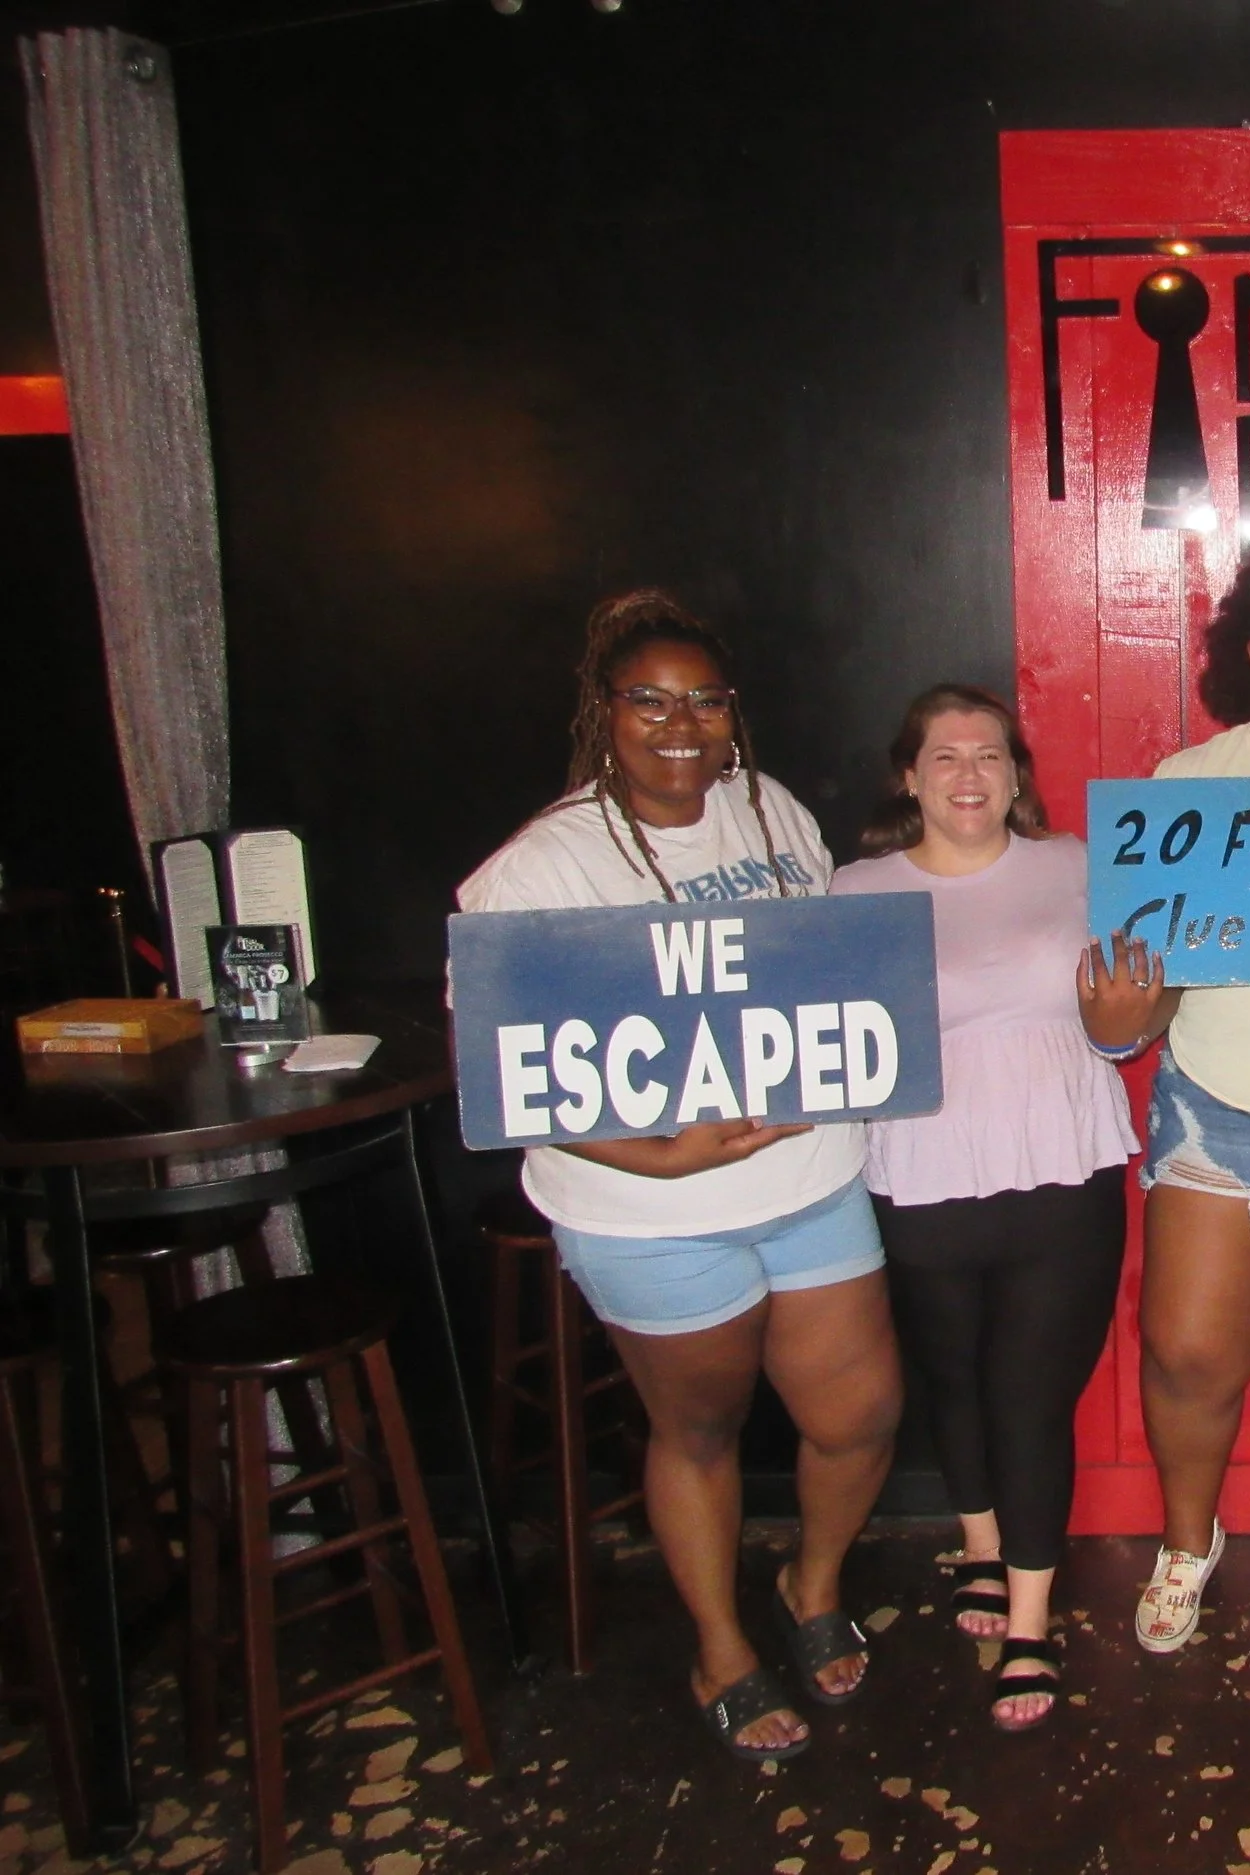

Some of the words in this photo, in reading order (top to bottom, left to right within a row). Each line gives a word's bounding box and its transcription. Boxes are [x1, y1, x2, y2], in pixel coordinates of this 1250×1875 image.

[1112, 808, 1204, 866] 20
[649, 917, 749, 997] WE
[497, 1000, 899, 1138] ESCAPED
